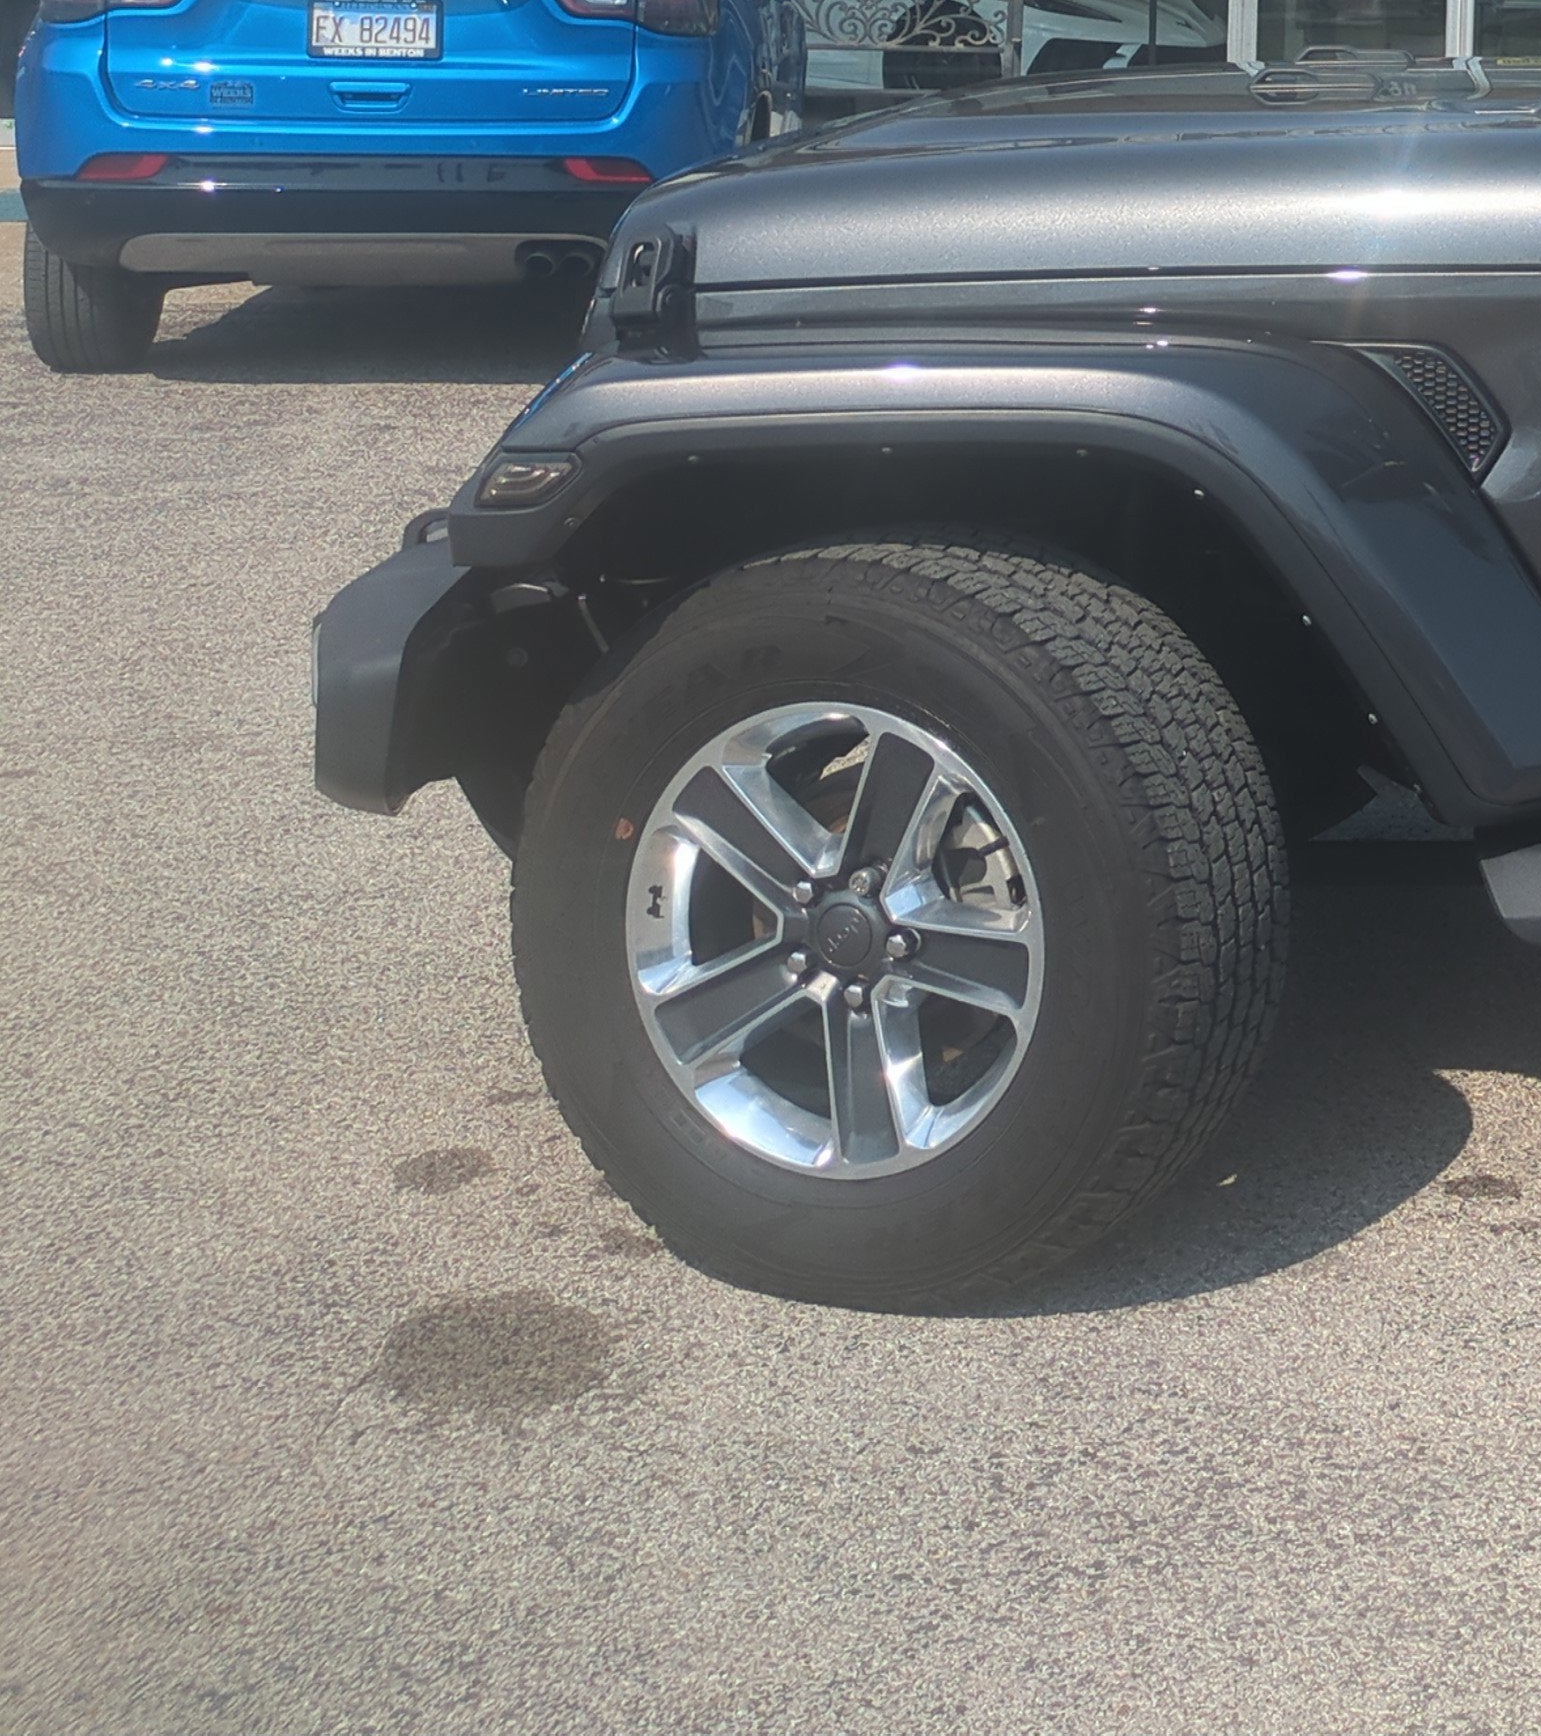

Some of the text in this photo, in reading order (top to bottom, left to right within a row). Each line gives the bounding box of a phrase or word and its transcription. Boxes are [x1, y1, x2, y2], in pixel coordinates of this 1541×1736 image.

[359, 16, 431, 45] 82494
[323, 47, 425, 58] WEEKS IN BENTON
